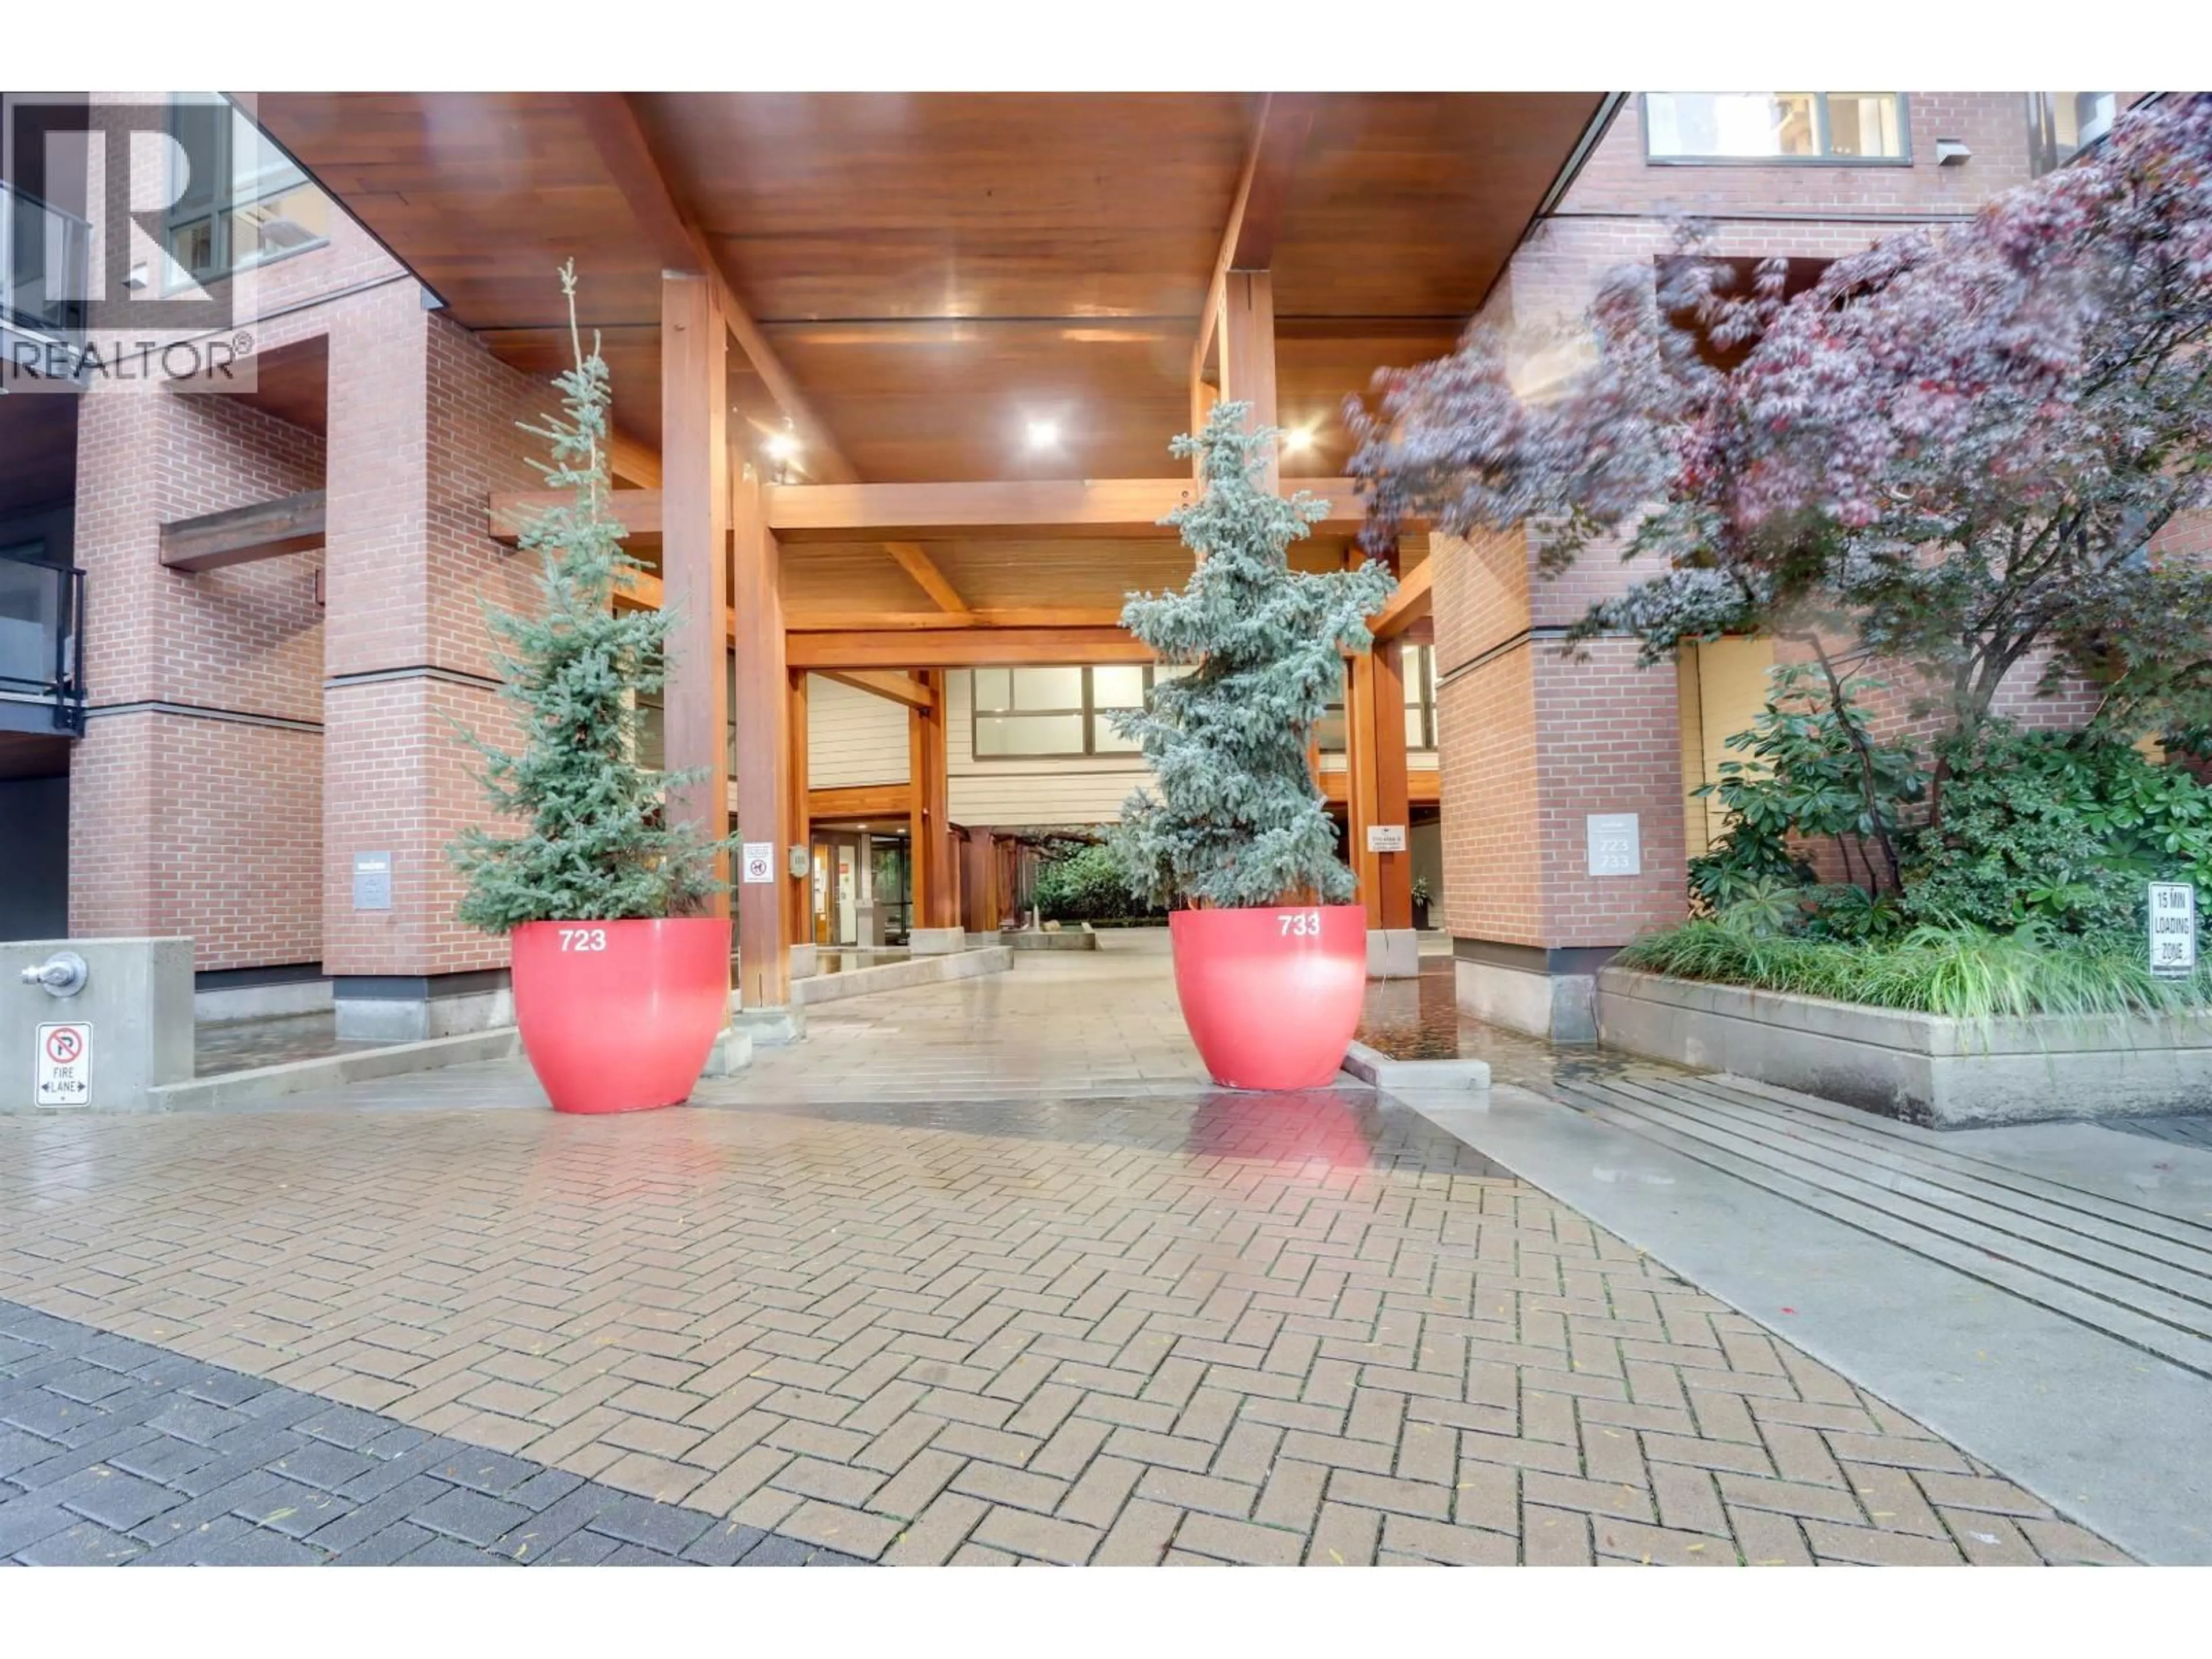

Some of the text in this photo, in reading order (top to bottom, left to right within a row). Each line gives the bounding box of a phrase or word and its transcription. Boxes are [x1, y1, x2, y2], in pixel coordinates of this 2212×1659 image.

[1600, 839, 1630, 852] 723
[1601, 855, 1629, 868] 733
[2158, 891, 2186, 908] 15 MIN
[1277, 913, 1320, 936] 733
[2155, 917, 2190, 934] LOADING
[558, 929, 606, 952] 723
[2162, 942, 2183, 959] ZONE
[54, 1067, 74, 1079] FIRE
[51, 1081, 76, 1093] LANE
